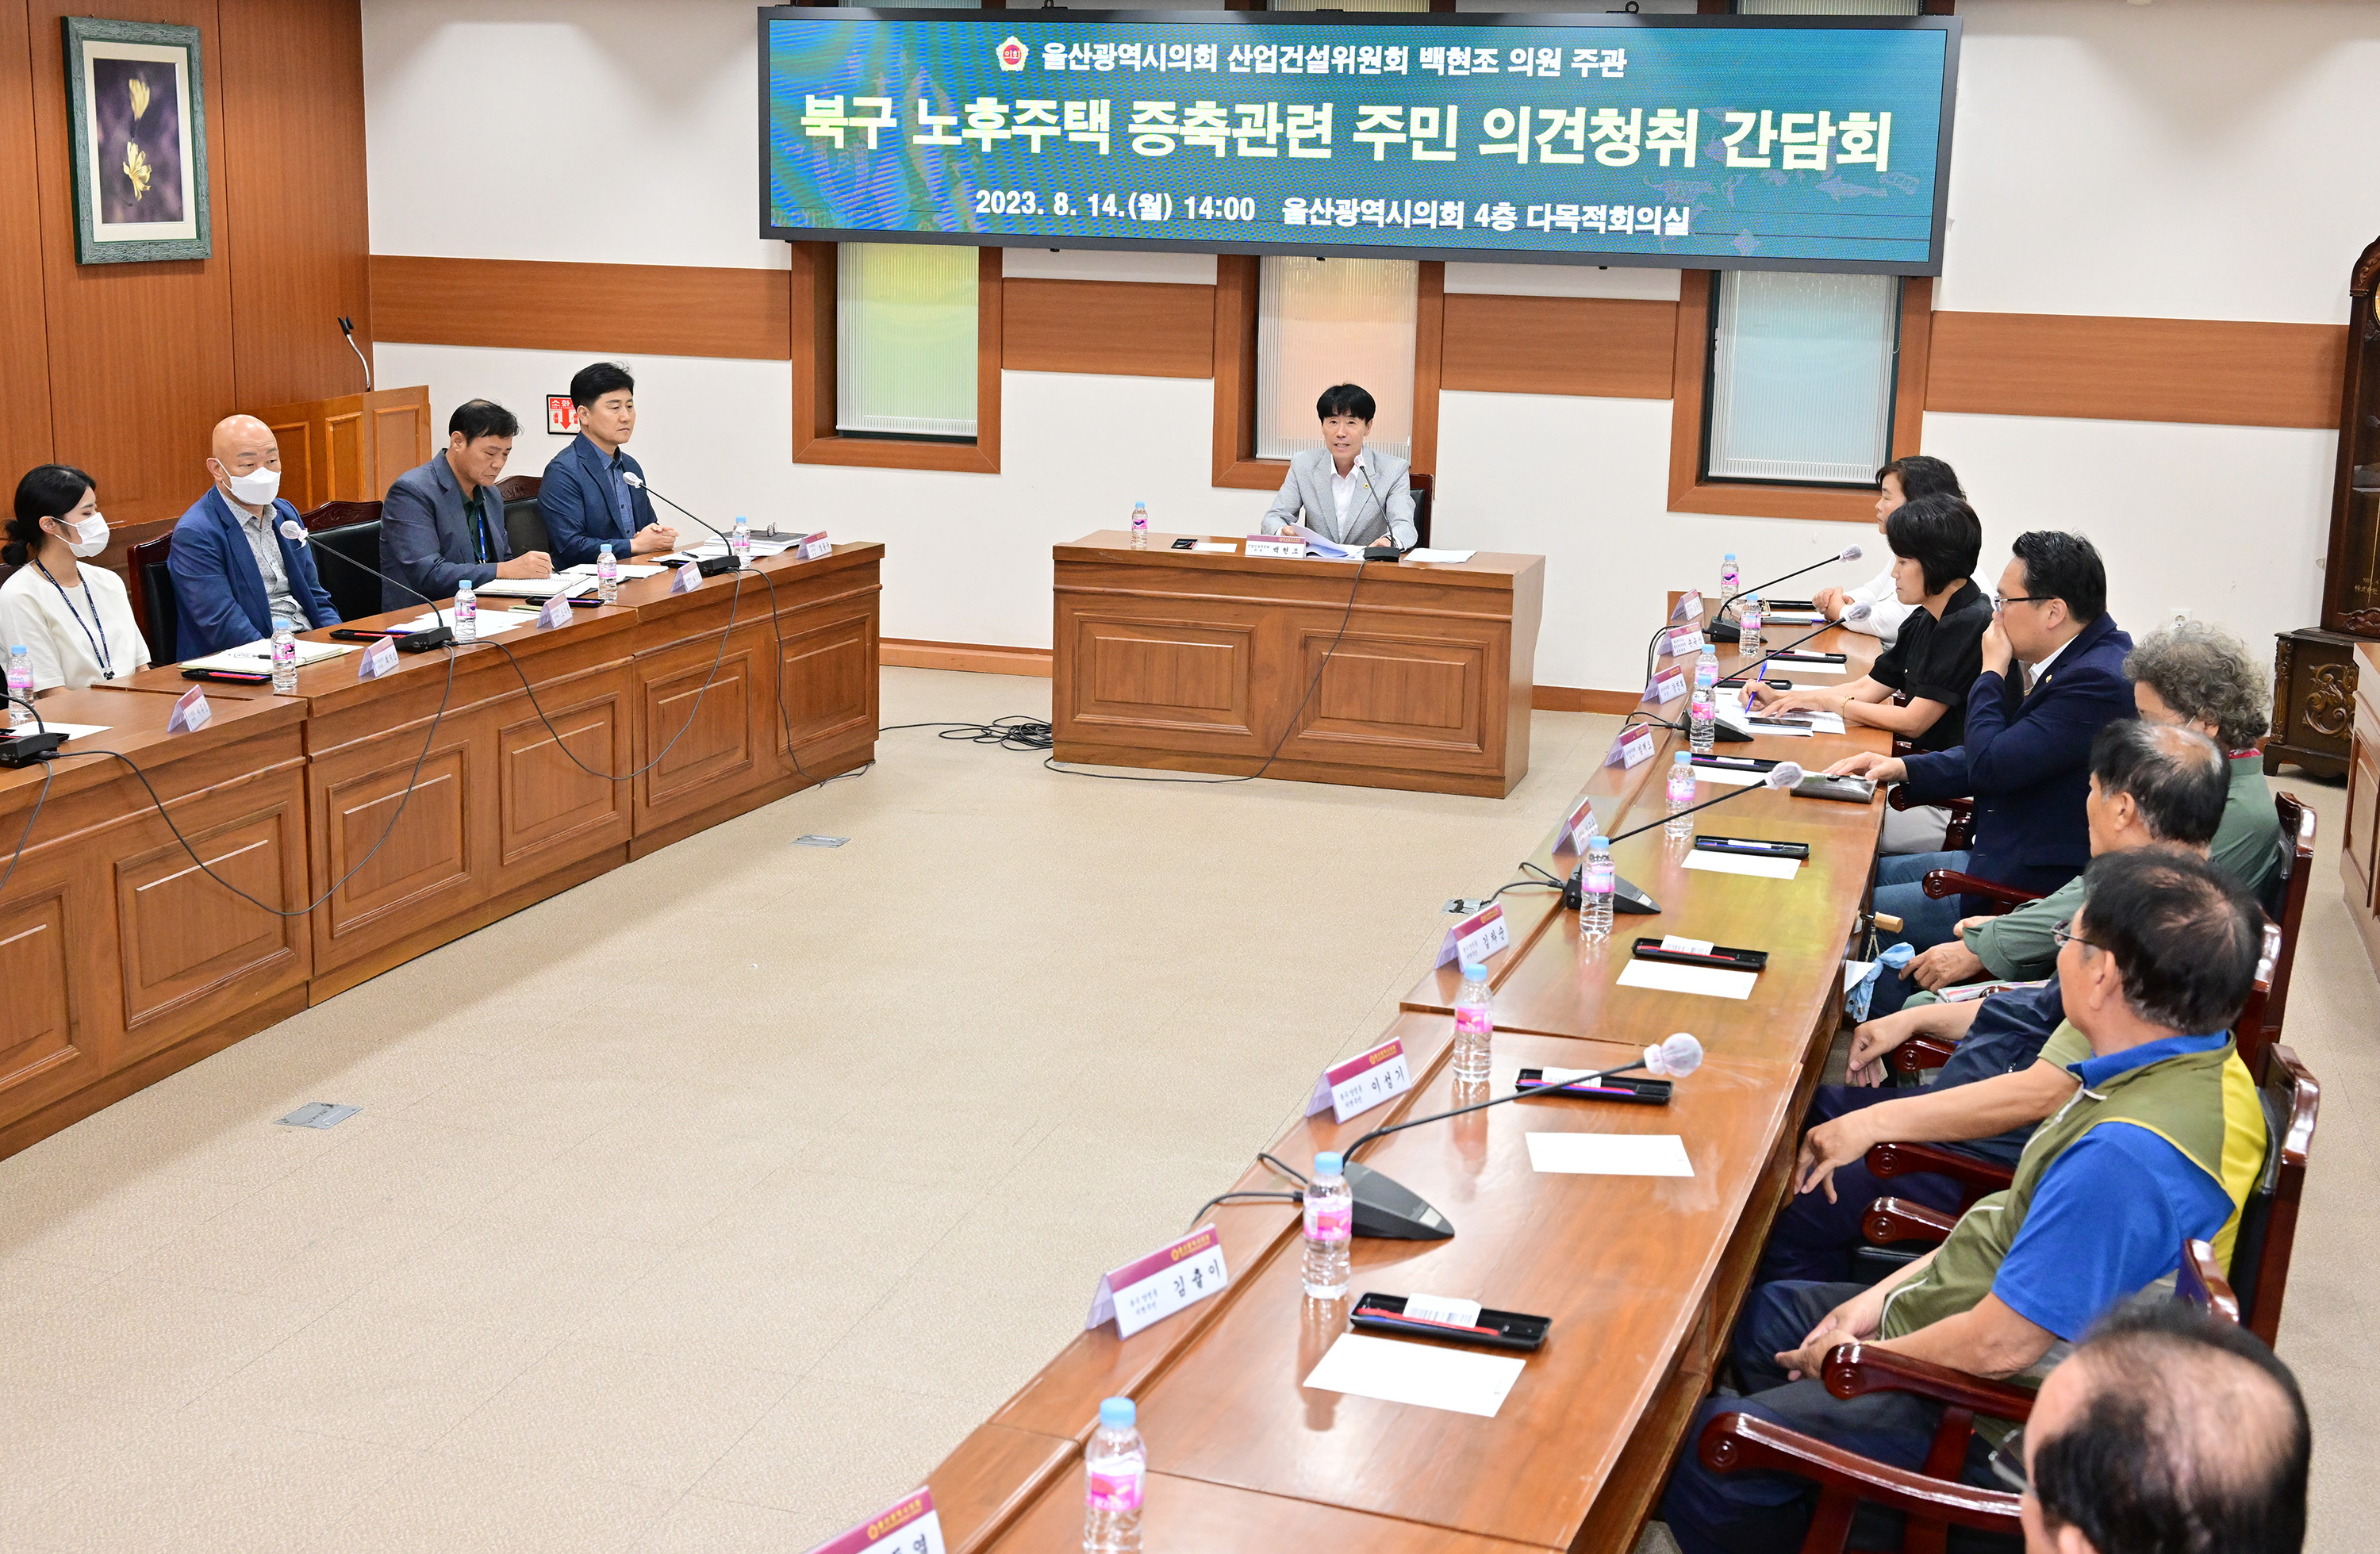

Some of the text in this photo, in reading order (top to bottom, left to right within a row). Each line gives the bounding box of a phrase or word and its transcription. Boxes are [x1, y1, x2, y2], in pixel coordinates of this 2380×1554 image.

[1004, 49, 1019, 59] 의회
[1042, 42, 1628, 78] 울산광역시의회 산업건설위원회 백현조 의원 주관
[800, 94, 1892, 172] 북구 노후주택 증축관련 주민 의견청취 간담회
[975, 190, 1690, 236] 2023. 8. 14.(월) 14:00 울산광역시의회 4층 다목적회의실
